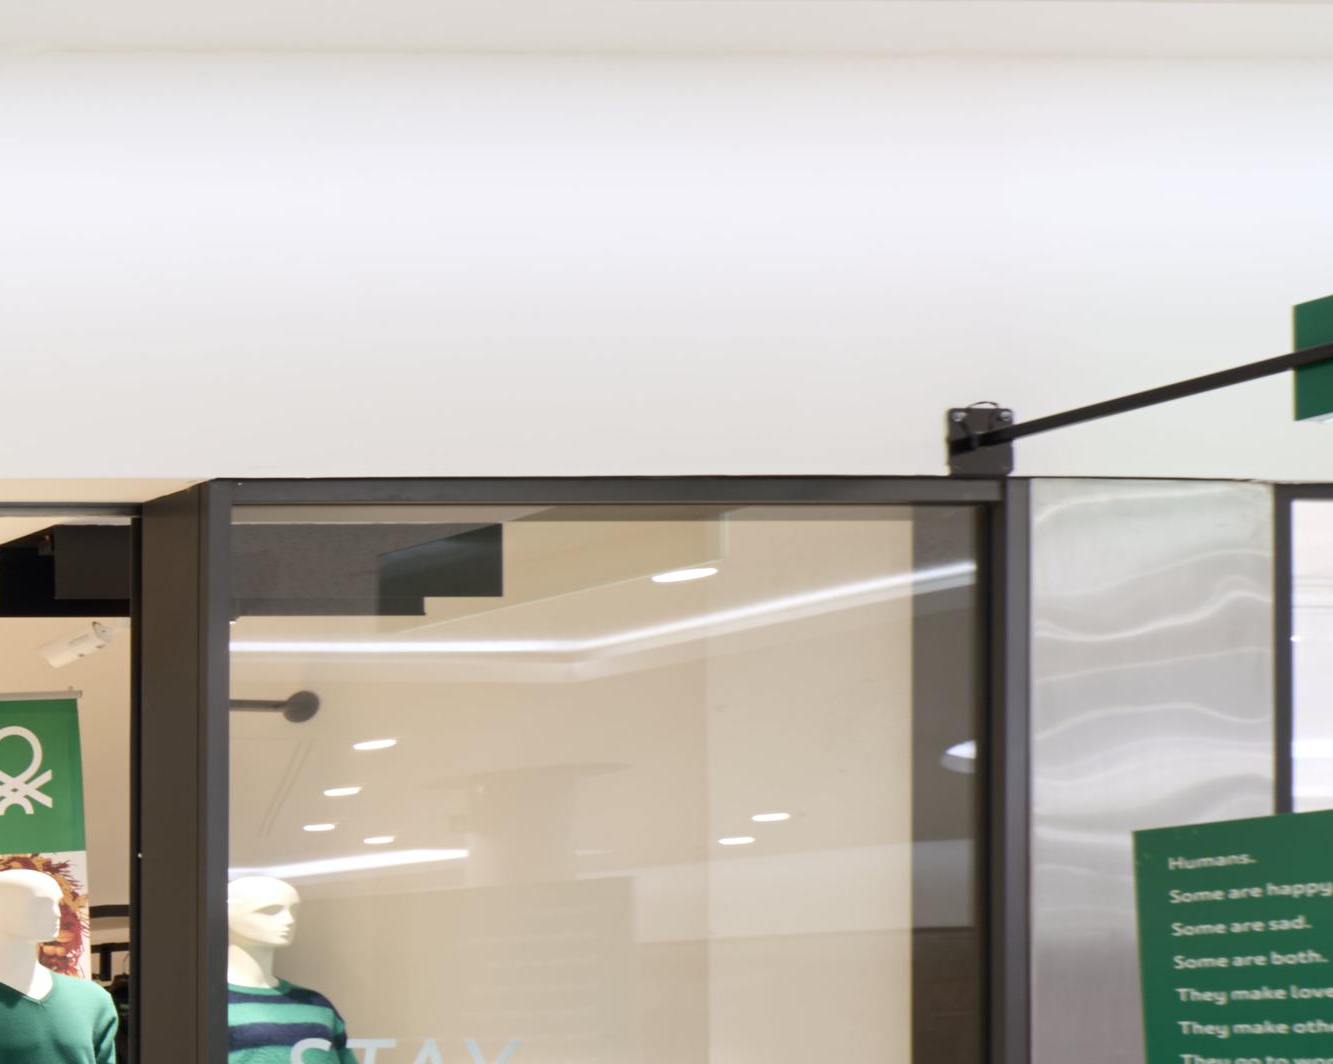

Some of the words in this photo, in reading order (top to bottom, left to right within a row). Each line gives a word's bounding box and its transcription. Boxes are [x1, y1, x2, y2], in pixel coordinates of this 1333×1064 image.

[1168, 854, 1258, 870] Humans.
[1169, 889, 1225, 903] Some
[1228, 886, 1263, 899] are
[1171, 922, 1227, 936] Some
[1230, 921, 1265, 933] are
[1268, 915, 1313, 931] sad.
[1173, 955, 1229, 969] Some
[1232, 955, 1267, 966] are
[1270, 949, 1329, 965] both.
[1175, 987, 1228, 1005] They
[1231, 986, 1287, 1000] make
[1176, 1020, 1230, 1038] They
[1233, 1020, 1289, 1034] make
